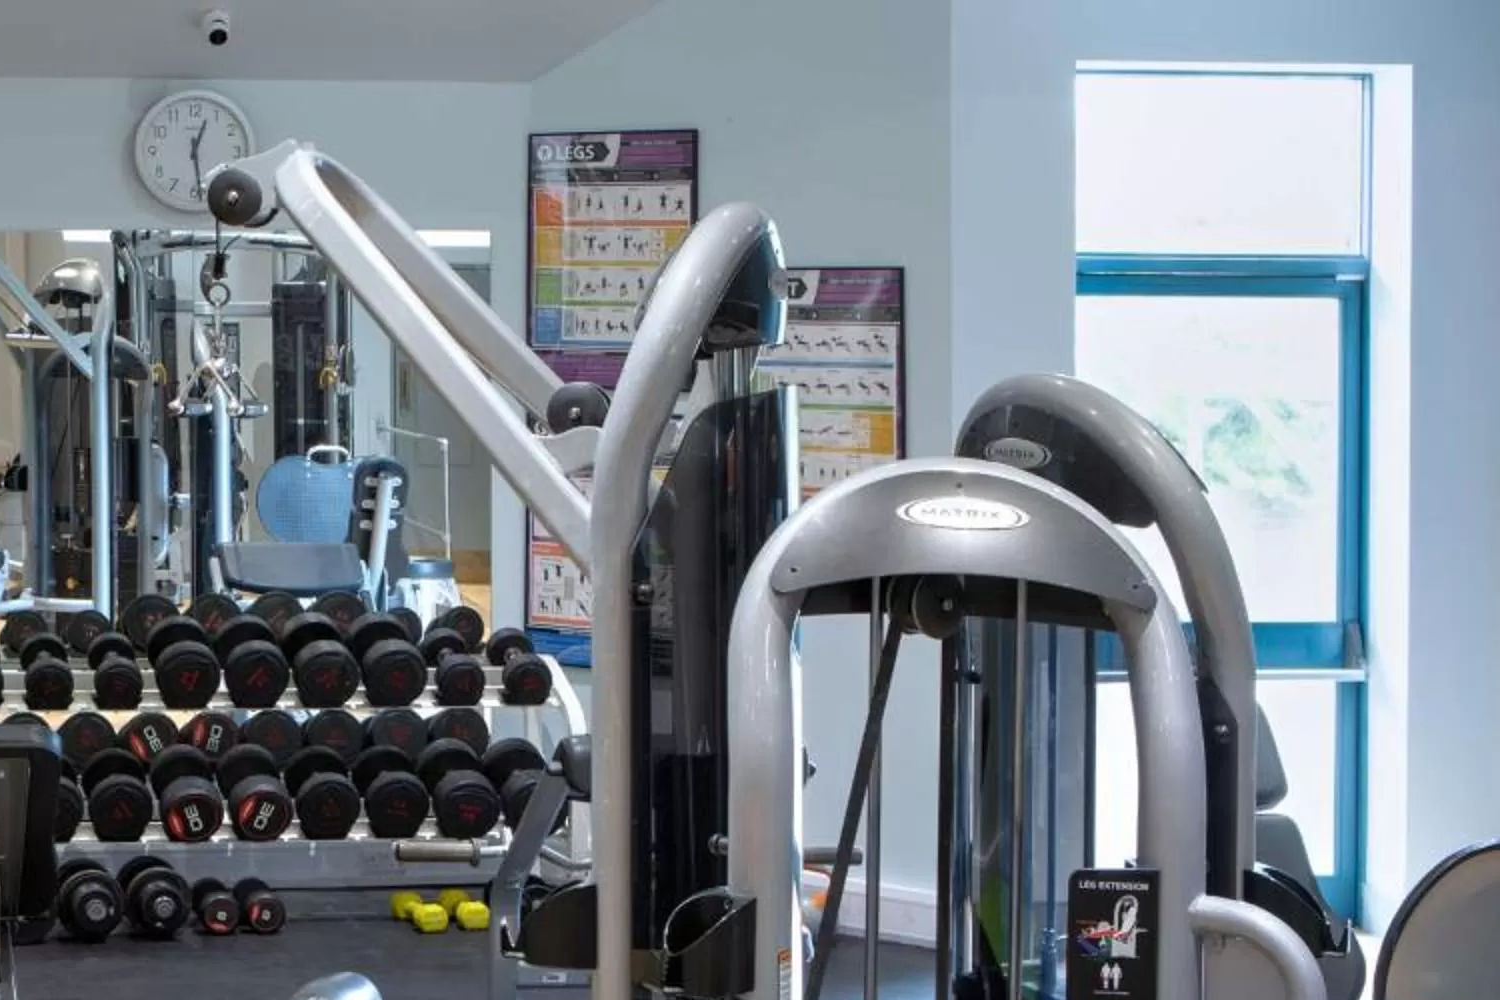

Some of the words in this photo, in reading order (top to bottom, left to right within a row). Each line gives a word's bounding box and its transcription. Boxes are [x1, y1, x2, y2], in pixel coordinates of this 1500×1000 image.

[168, 108, 179, 123] 11
[189, 103, 202, 118] 12
[555, 144, 596, 161] LEGS
[169, 177, 180, 192] 7
[921, 507, 1000, 519] MATRIX
[184, 803, 203, 832] 30
[254, 801, 275, 831] 30
[1079, 879, 1097, 889] LEG
[1098, 881, 1149, 891] EXTENSION
